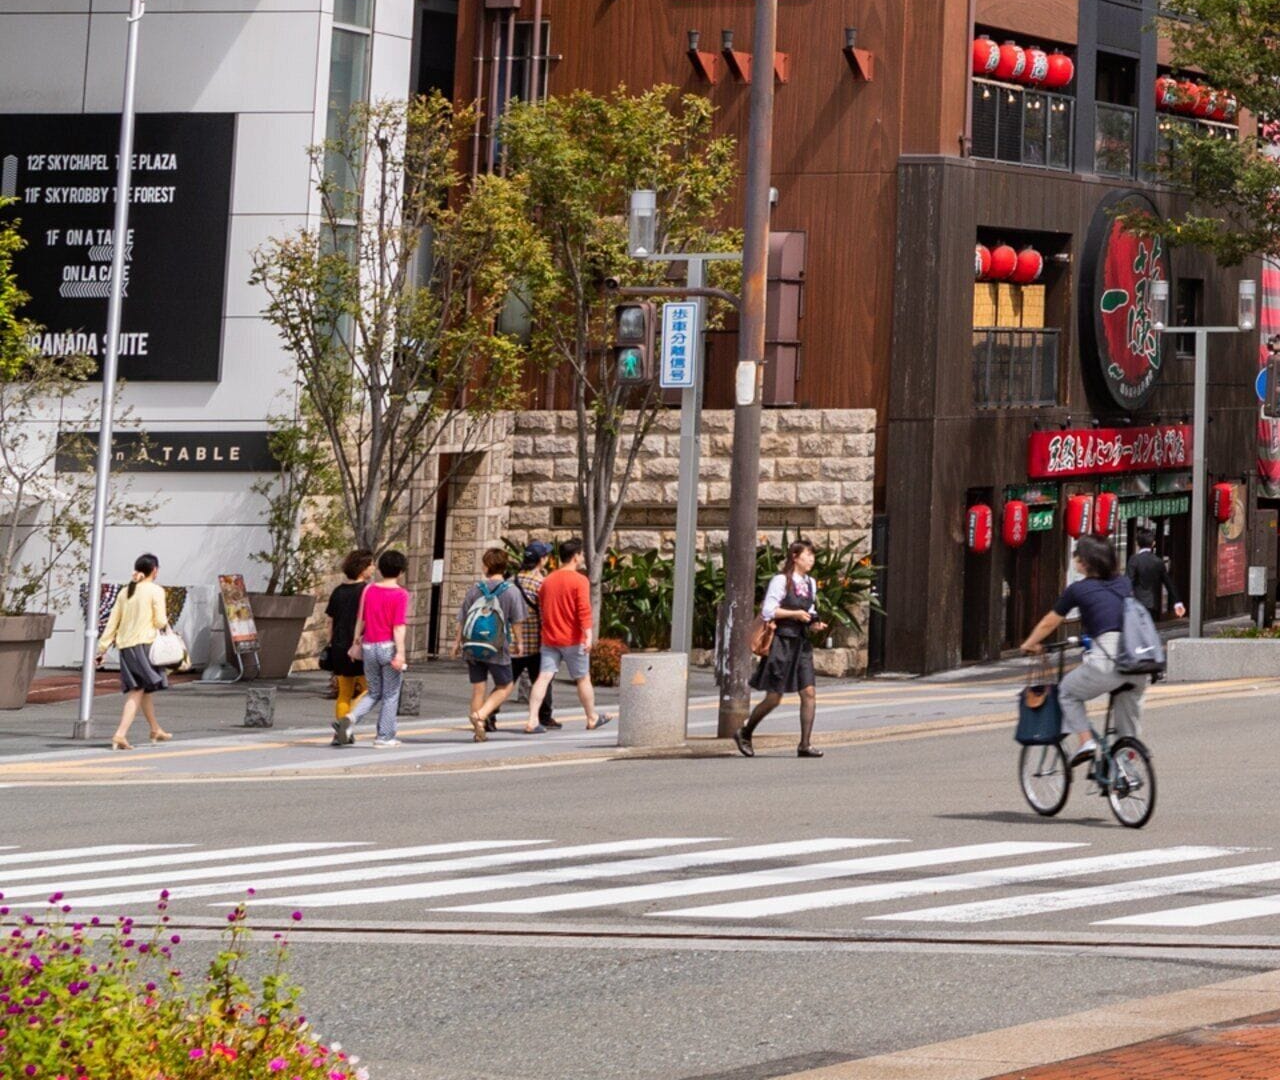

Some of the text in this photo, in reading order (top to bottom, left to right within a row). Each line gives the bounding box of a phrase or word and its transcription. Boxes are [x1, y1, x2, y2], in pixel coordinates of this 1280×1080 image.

[27, 154, 177, 170] 12F SKYCHAPEL TE PLAZA
[25, 187, 175, 203] 11F SKYROBBY TE FOREST
[47, 229, 135, 245] 1F ON A TAE
[63, 265, 130, 281] ON LA CAE
[162, 446, 241, 461] TABLE
